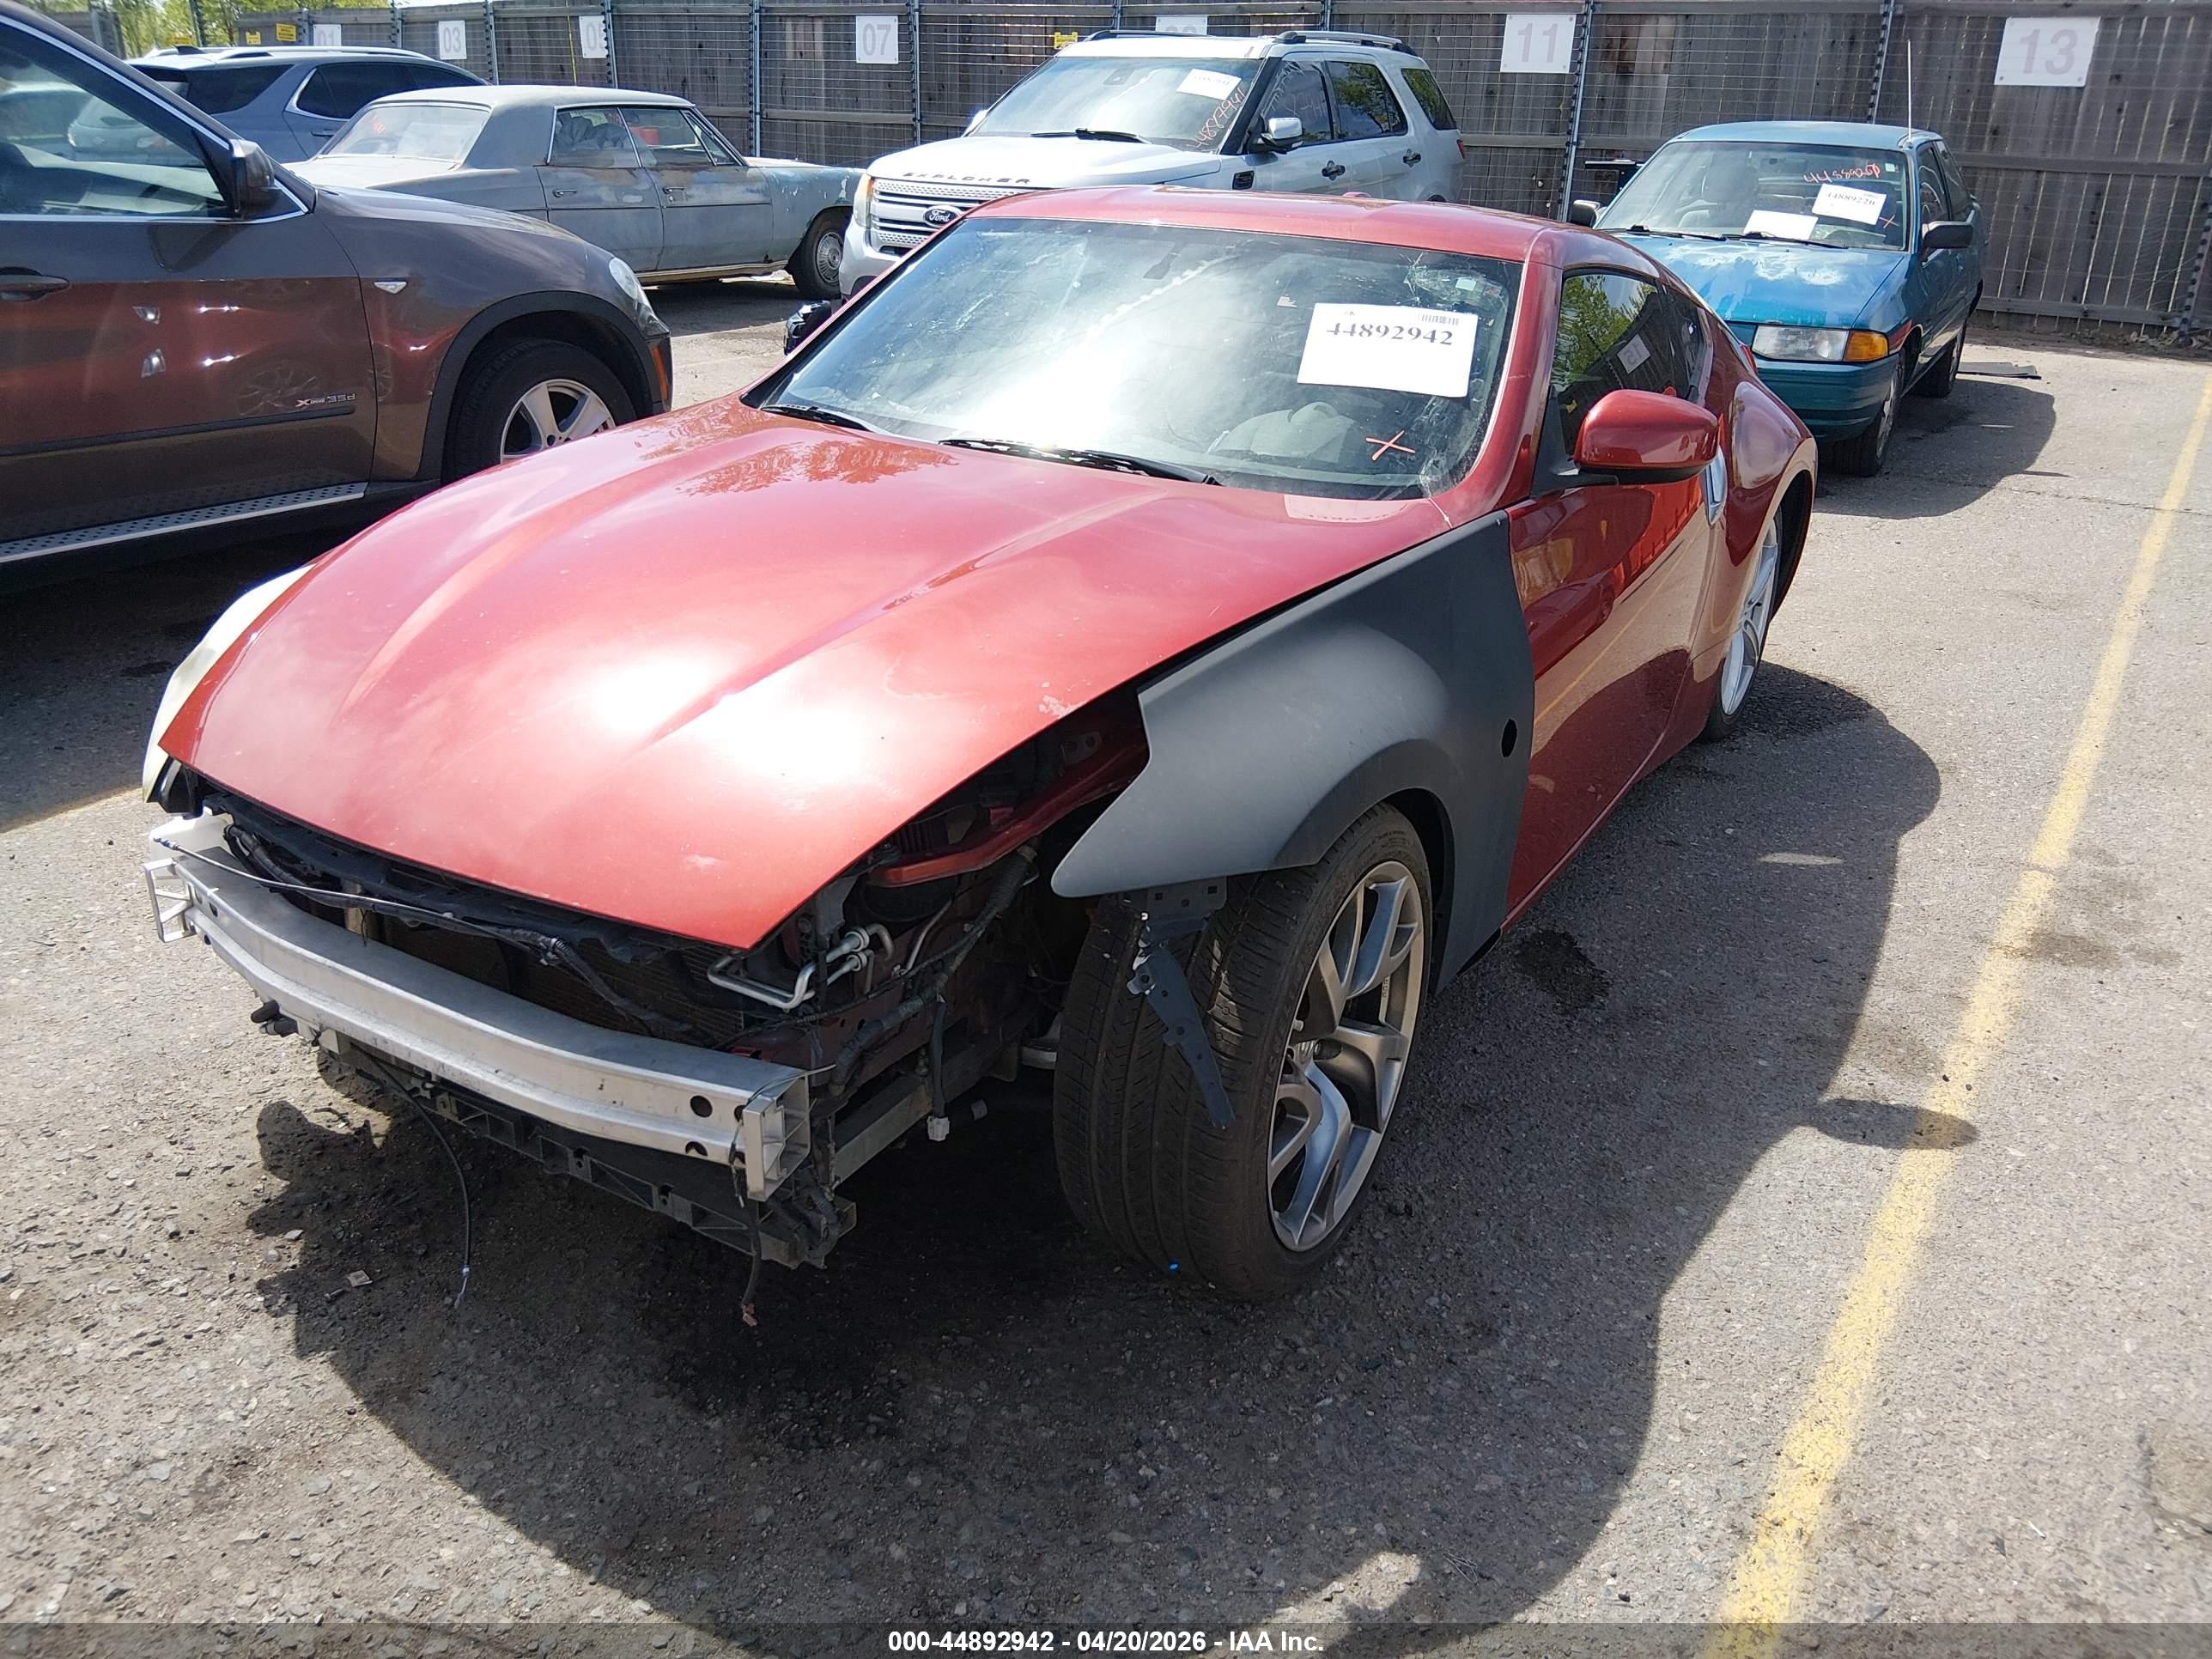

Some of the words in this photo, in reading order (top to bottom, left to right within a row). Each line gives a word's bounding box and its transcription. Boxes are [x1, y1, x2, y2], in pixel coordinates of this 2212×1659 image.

[443, 27, 461, 53] 03
[863, 23, 891, 55] 07
[1518, 23, 1558, 63] 11
[2020, 29, 2078, 75] 13
[902, 173, 1030, 183] EXPLORER
[929, 209, 951, 223] Ford
[1327, 322, 1453, 345] 44892942
